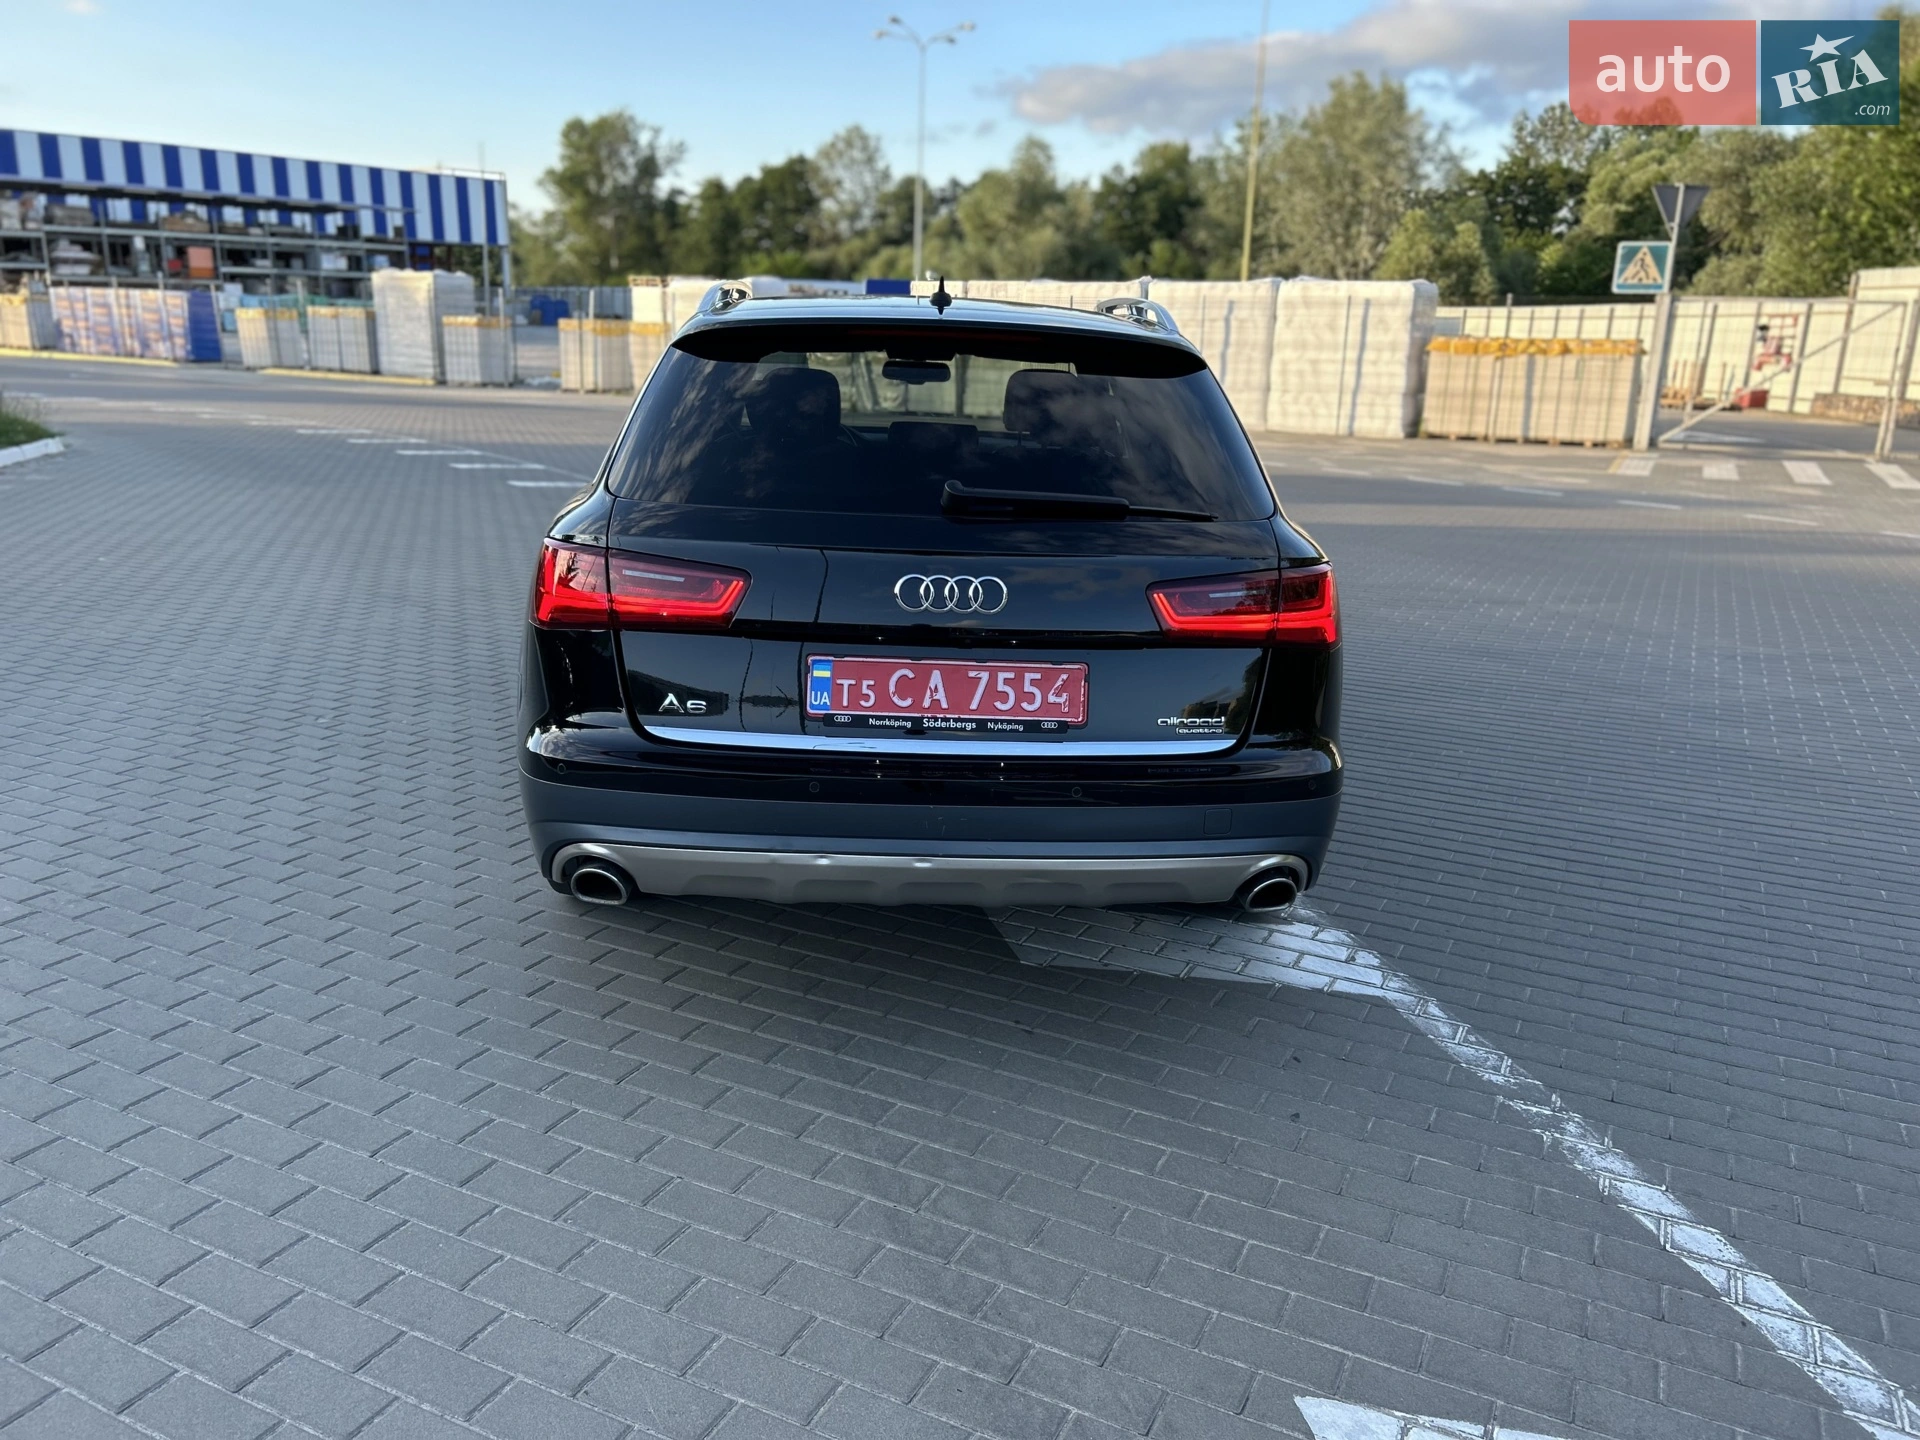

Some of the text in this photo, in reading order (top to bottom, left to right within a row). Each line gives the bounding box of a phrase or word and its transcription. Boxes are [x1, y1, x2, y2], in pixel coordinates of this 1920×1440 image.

[836, 668, 1070, 713] T5 CA 7554
[658, 693, 707, 714] A6
[811, 691, 830, 706] UA
[868, 718, 1024, 731] Norrköping Söderbergs Nyköping
[1157, 716, 1226, 726] allroad
